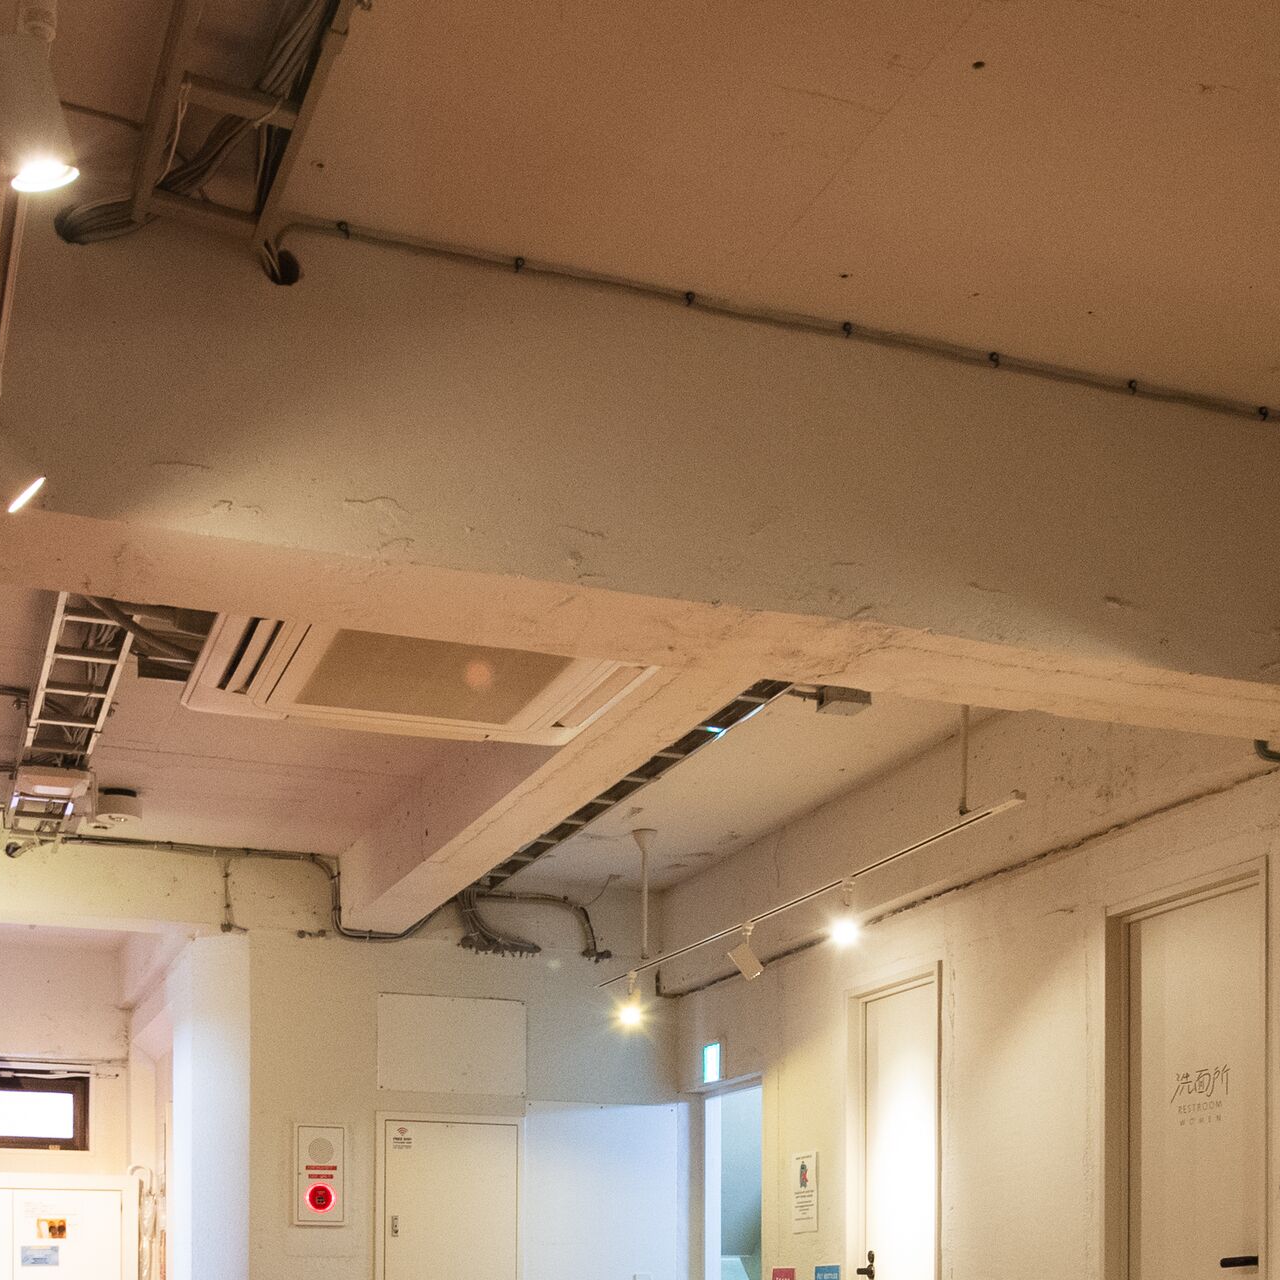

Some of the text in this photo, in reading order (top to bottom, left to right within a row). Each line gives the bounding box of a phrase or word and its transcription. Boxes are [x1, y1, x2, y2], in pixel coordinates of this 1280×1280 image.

[1170, 1064, 1231, 1103] 洗面所
[1178, 1100, 1222, 1113] RESTROOM
